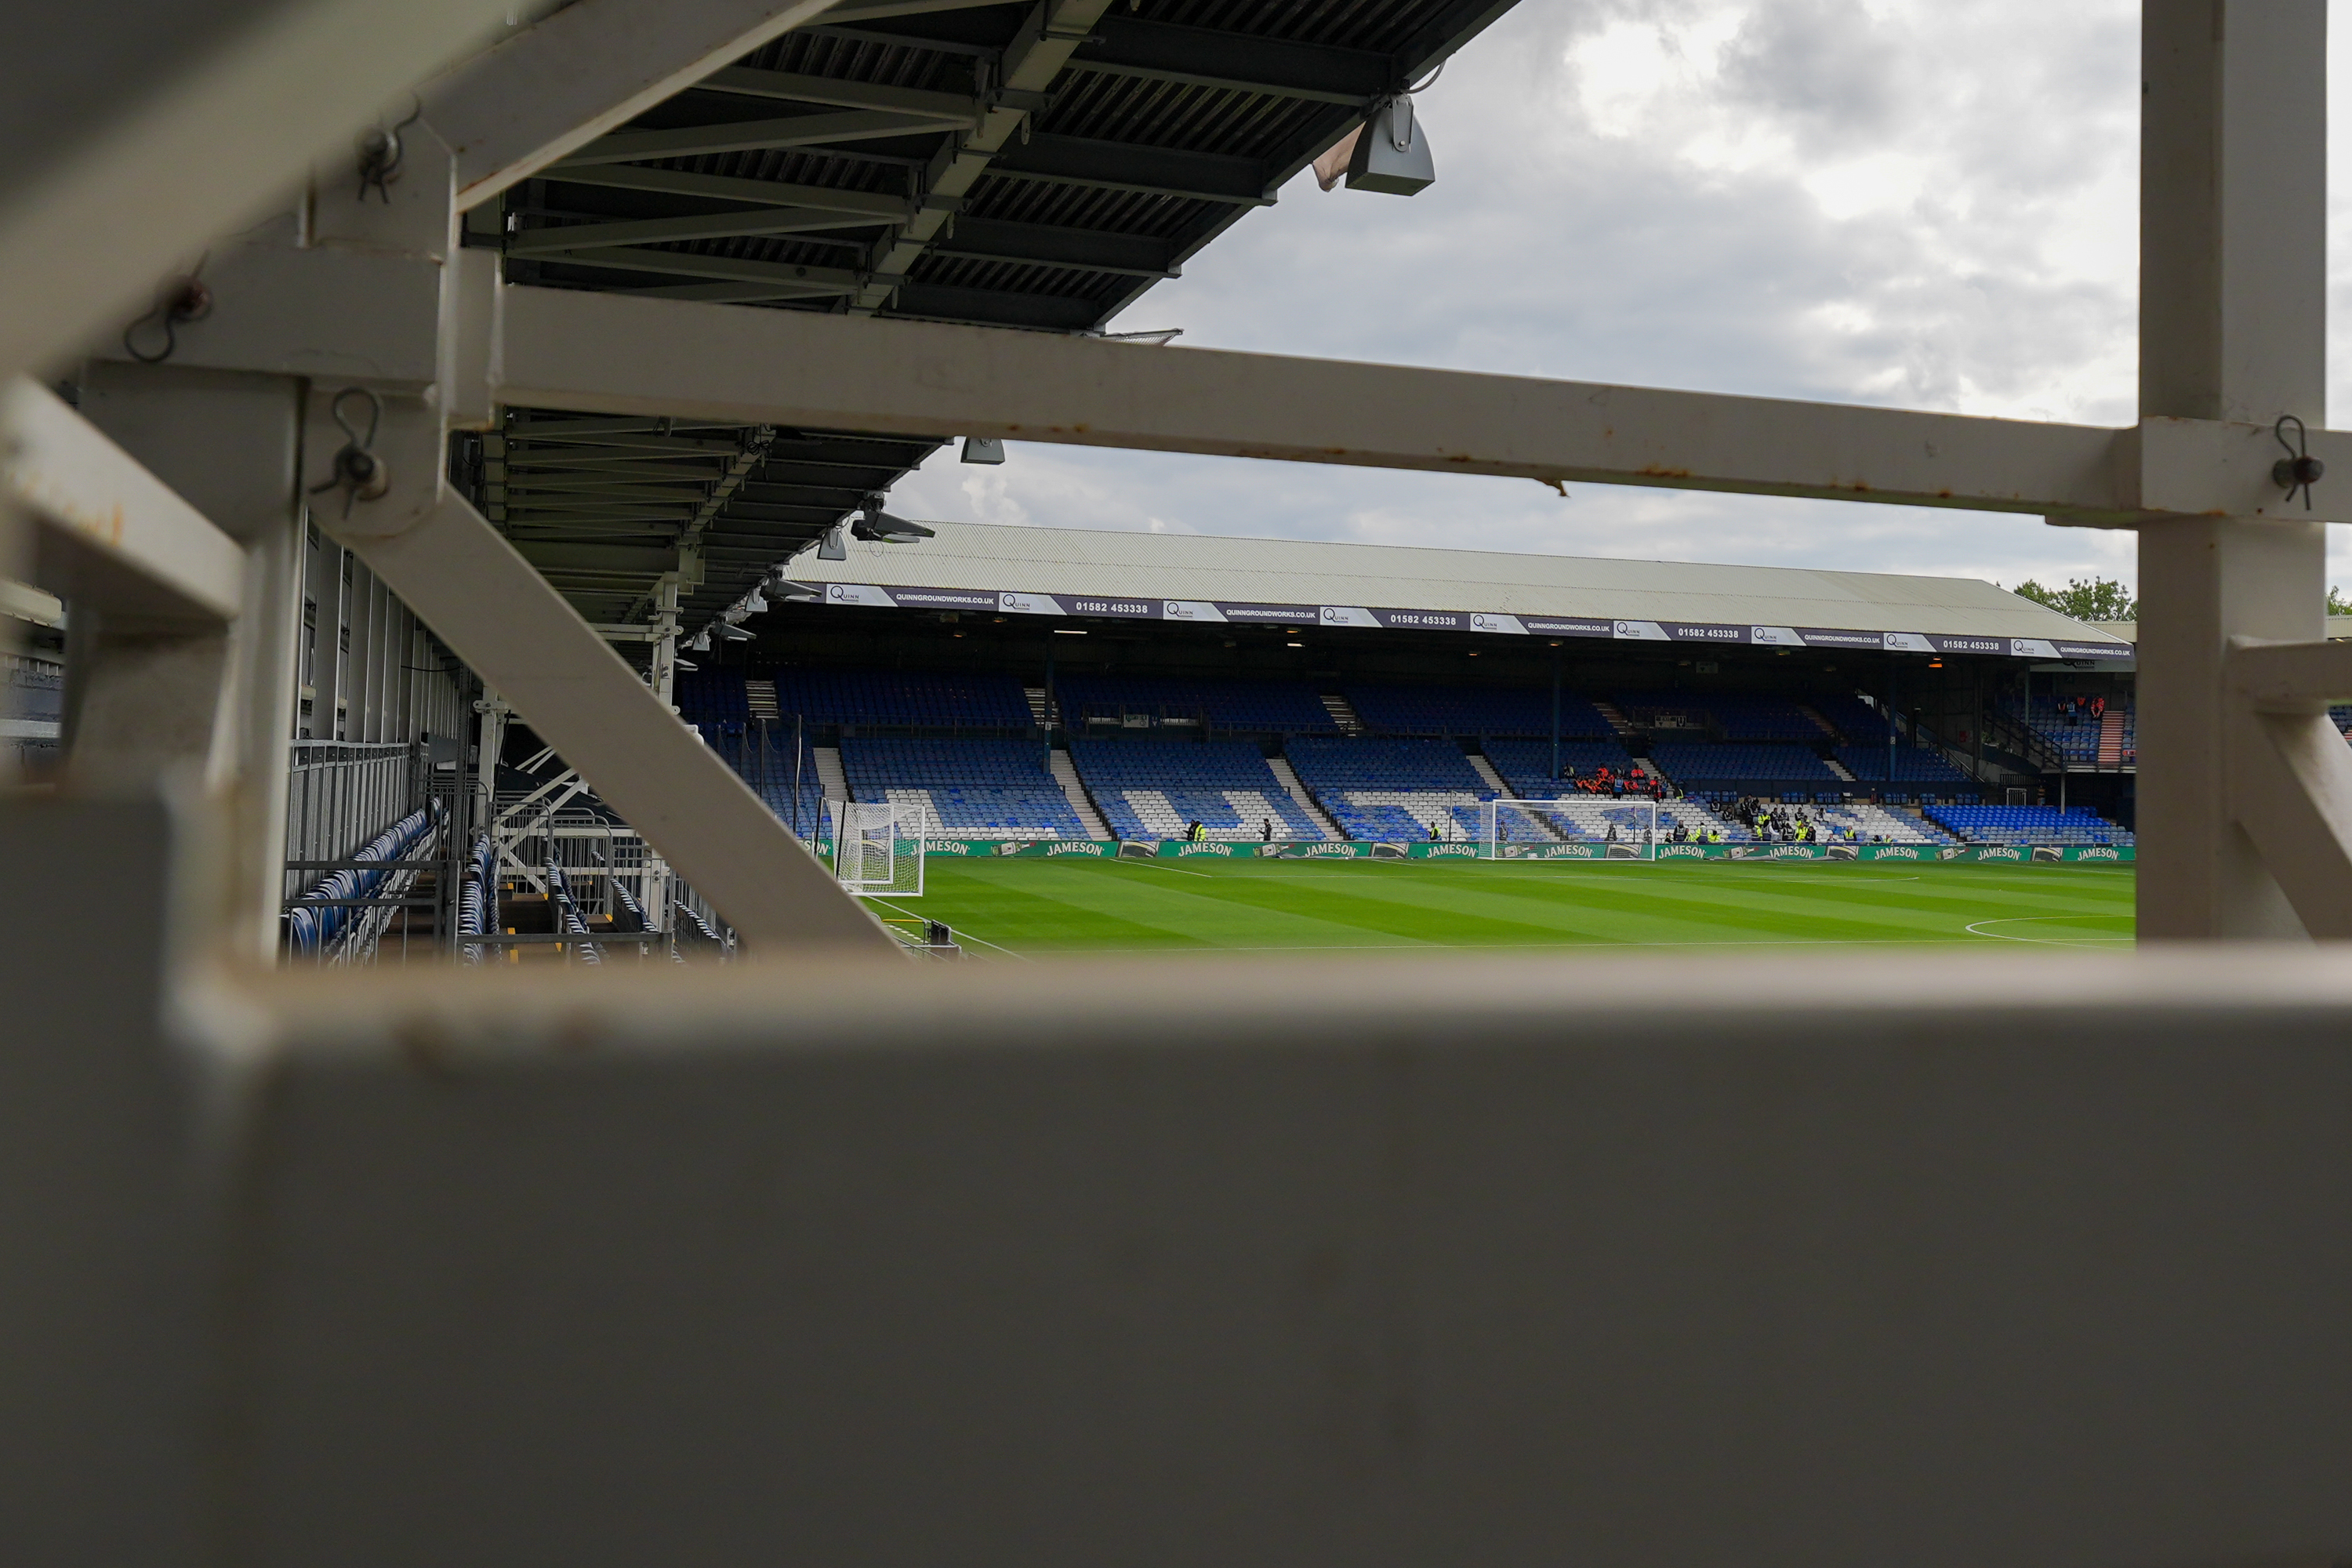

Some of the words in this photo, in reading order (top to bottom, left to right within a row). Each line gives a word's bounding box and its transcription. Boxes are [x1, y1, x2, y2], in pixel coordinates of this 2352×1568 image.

[896, 593, 994, 605] QUINNGROUNDWORKS.CO.UK
[1076, 601, 1107, 612] 01582
[1110, 603, 1148, 614] 453338
[1226, 608, 1316, 619] QUINNGROUNDWORKS.CO.UK
[1390, 614, 1419, 623] 01582
[1422, 615, 1456, 626] 453338
[1528, 622, 1610, 633] QUINNGROUNDWORKS.CO.UK
[1678, 628, 1704, 637] 01582
[1707, 629, 1739, 638] 453338
[1943, 640, 1967, 649] 01582
[1970, 641, 1999, 651] 453338
[1047, 841, 1102, 856] JAMESON
[1178, 842, 1232, 857] JAMESON
[1305, 843, 1356, 857] JAMESON
[1427, 844, 1476, 858] JAMESON
[1544, 844, 1592, 858] JAMESON
[1658, 845, 1704, 859] JAMESON
[1769, 845, 1813, 859] JAMESON
[1875, 847, 1918, 860] JAMESON
[1978, 848, 2020, 861] JAMESON
[2078, 848, 2118, 861] JAMESON
